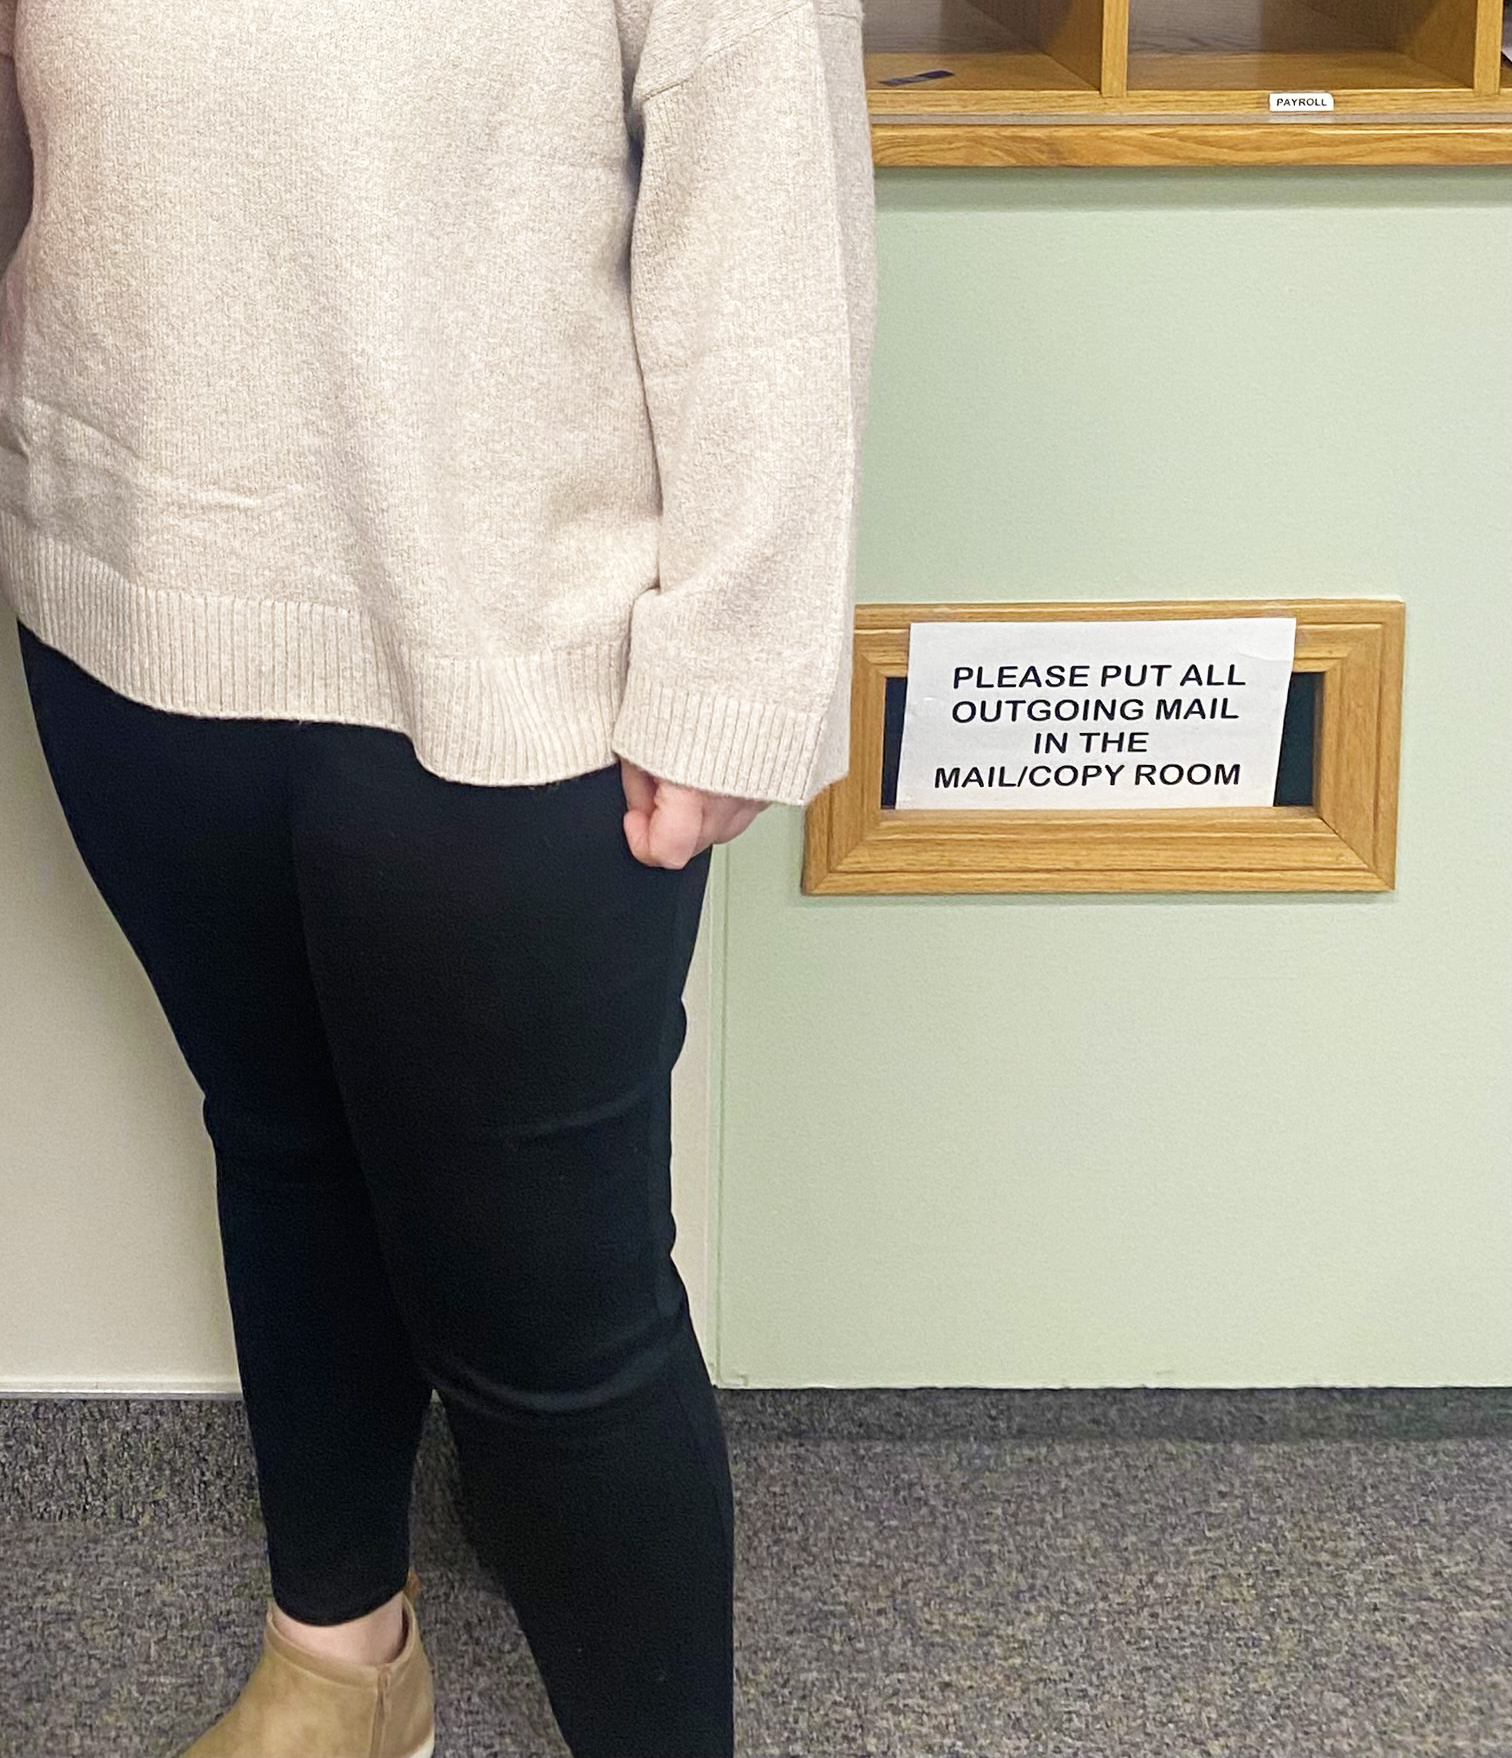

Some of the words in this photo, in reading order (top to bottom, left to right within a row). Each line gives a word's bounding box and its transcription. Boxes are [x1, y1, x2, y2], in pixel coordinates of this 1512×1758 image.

[1275, 96, 1328, 108] PAYROLL
[952, 664, 1090, 690] PLEASE
[1100, 663, 1171, 688] PUT
[1179, 662, 1246, 687] ALL
[951, 697, 1145, 724] OUTGOING
[1154, 695, 1239, 721] MAIL
[1033, 731, 1071, 754] IN
[1079, 730, 1150, 754] THE
[933, 763, 1127, 790] MAIL/COPY
[1134, 762, 1241, 787] ROOM
